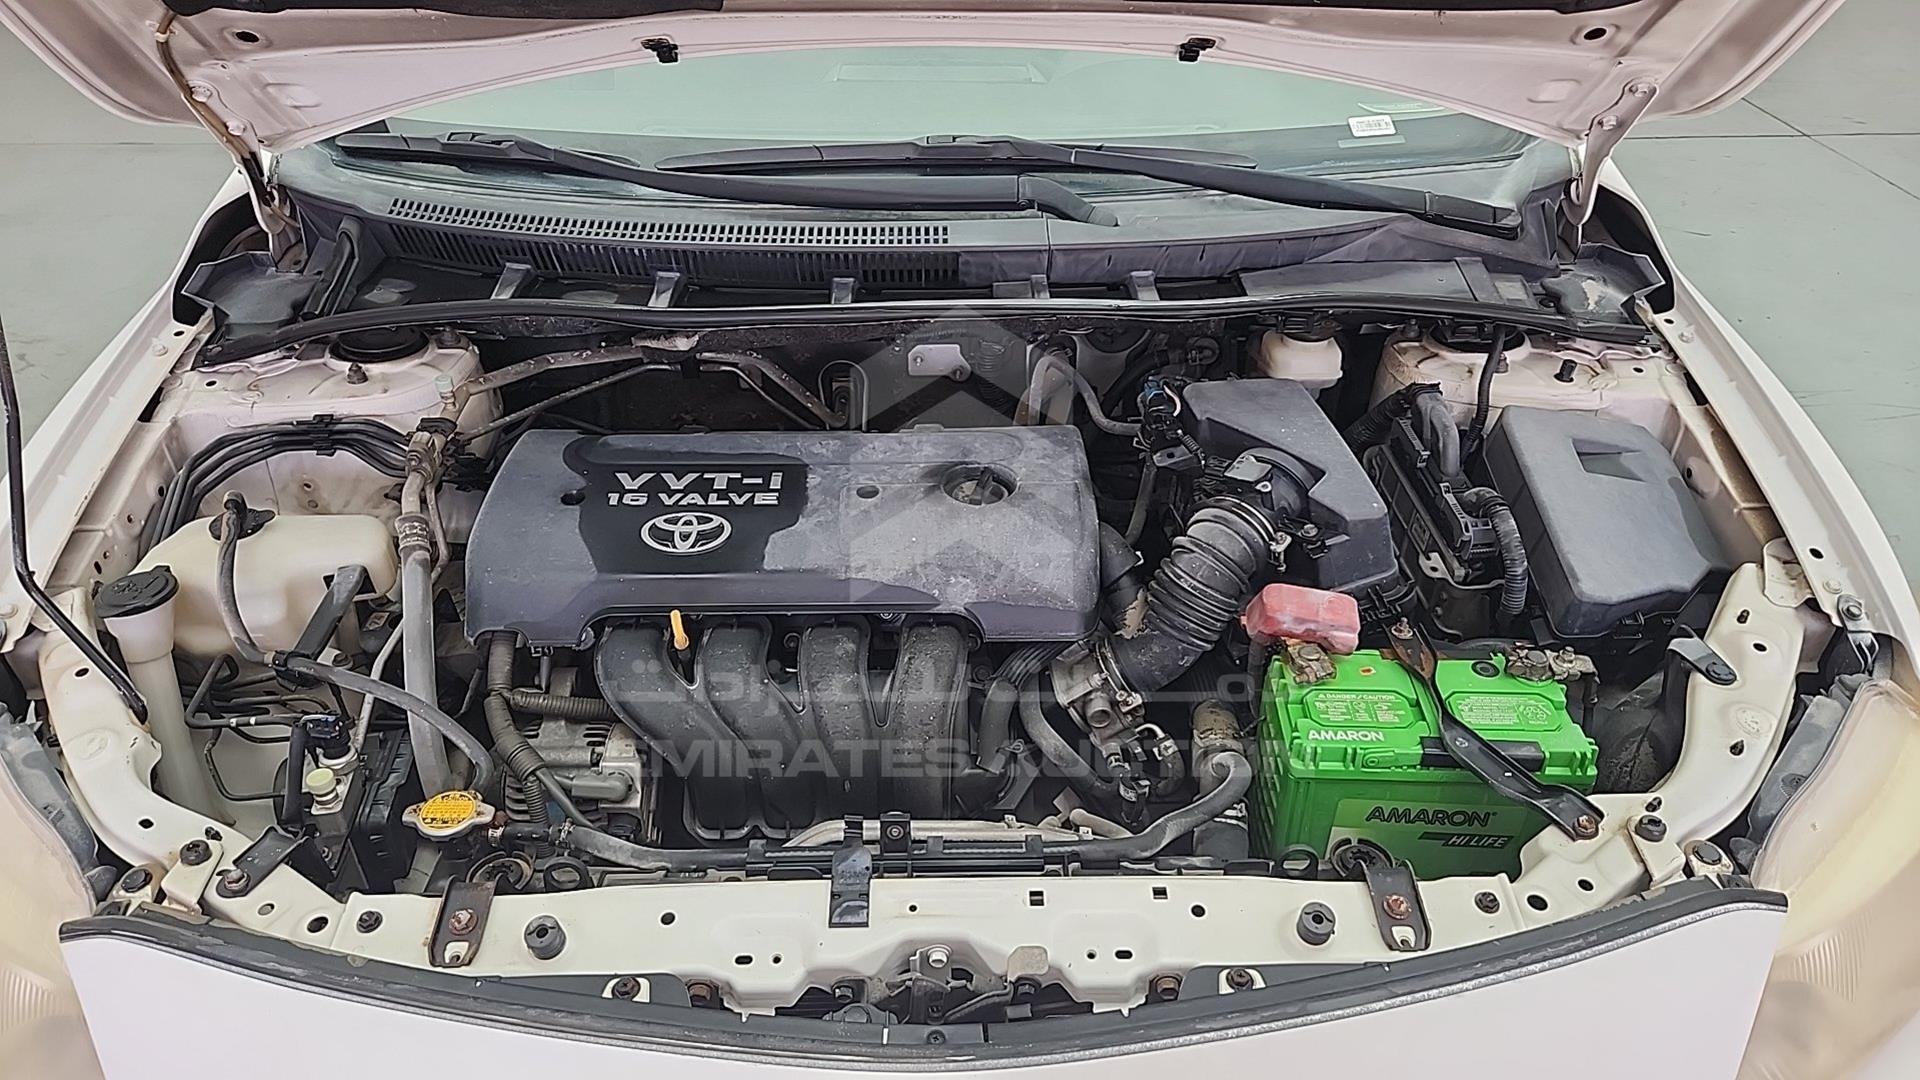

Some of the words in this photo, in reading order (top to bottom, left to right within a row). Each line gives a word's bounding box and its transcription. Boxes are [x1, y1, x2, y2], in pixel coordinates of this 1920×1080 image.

[607, 493, 648, 506] 16
[657, 492, 779, 506] VALVE
[1308, 729, 1385, 741] AMARON
[1365, 806, 1491, 828] AMARON
